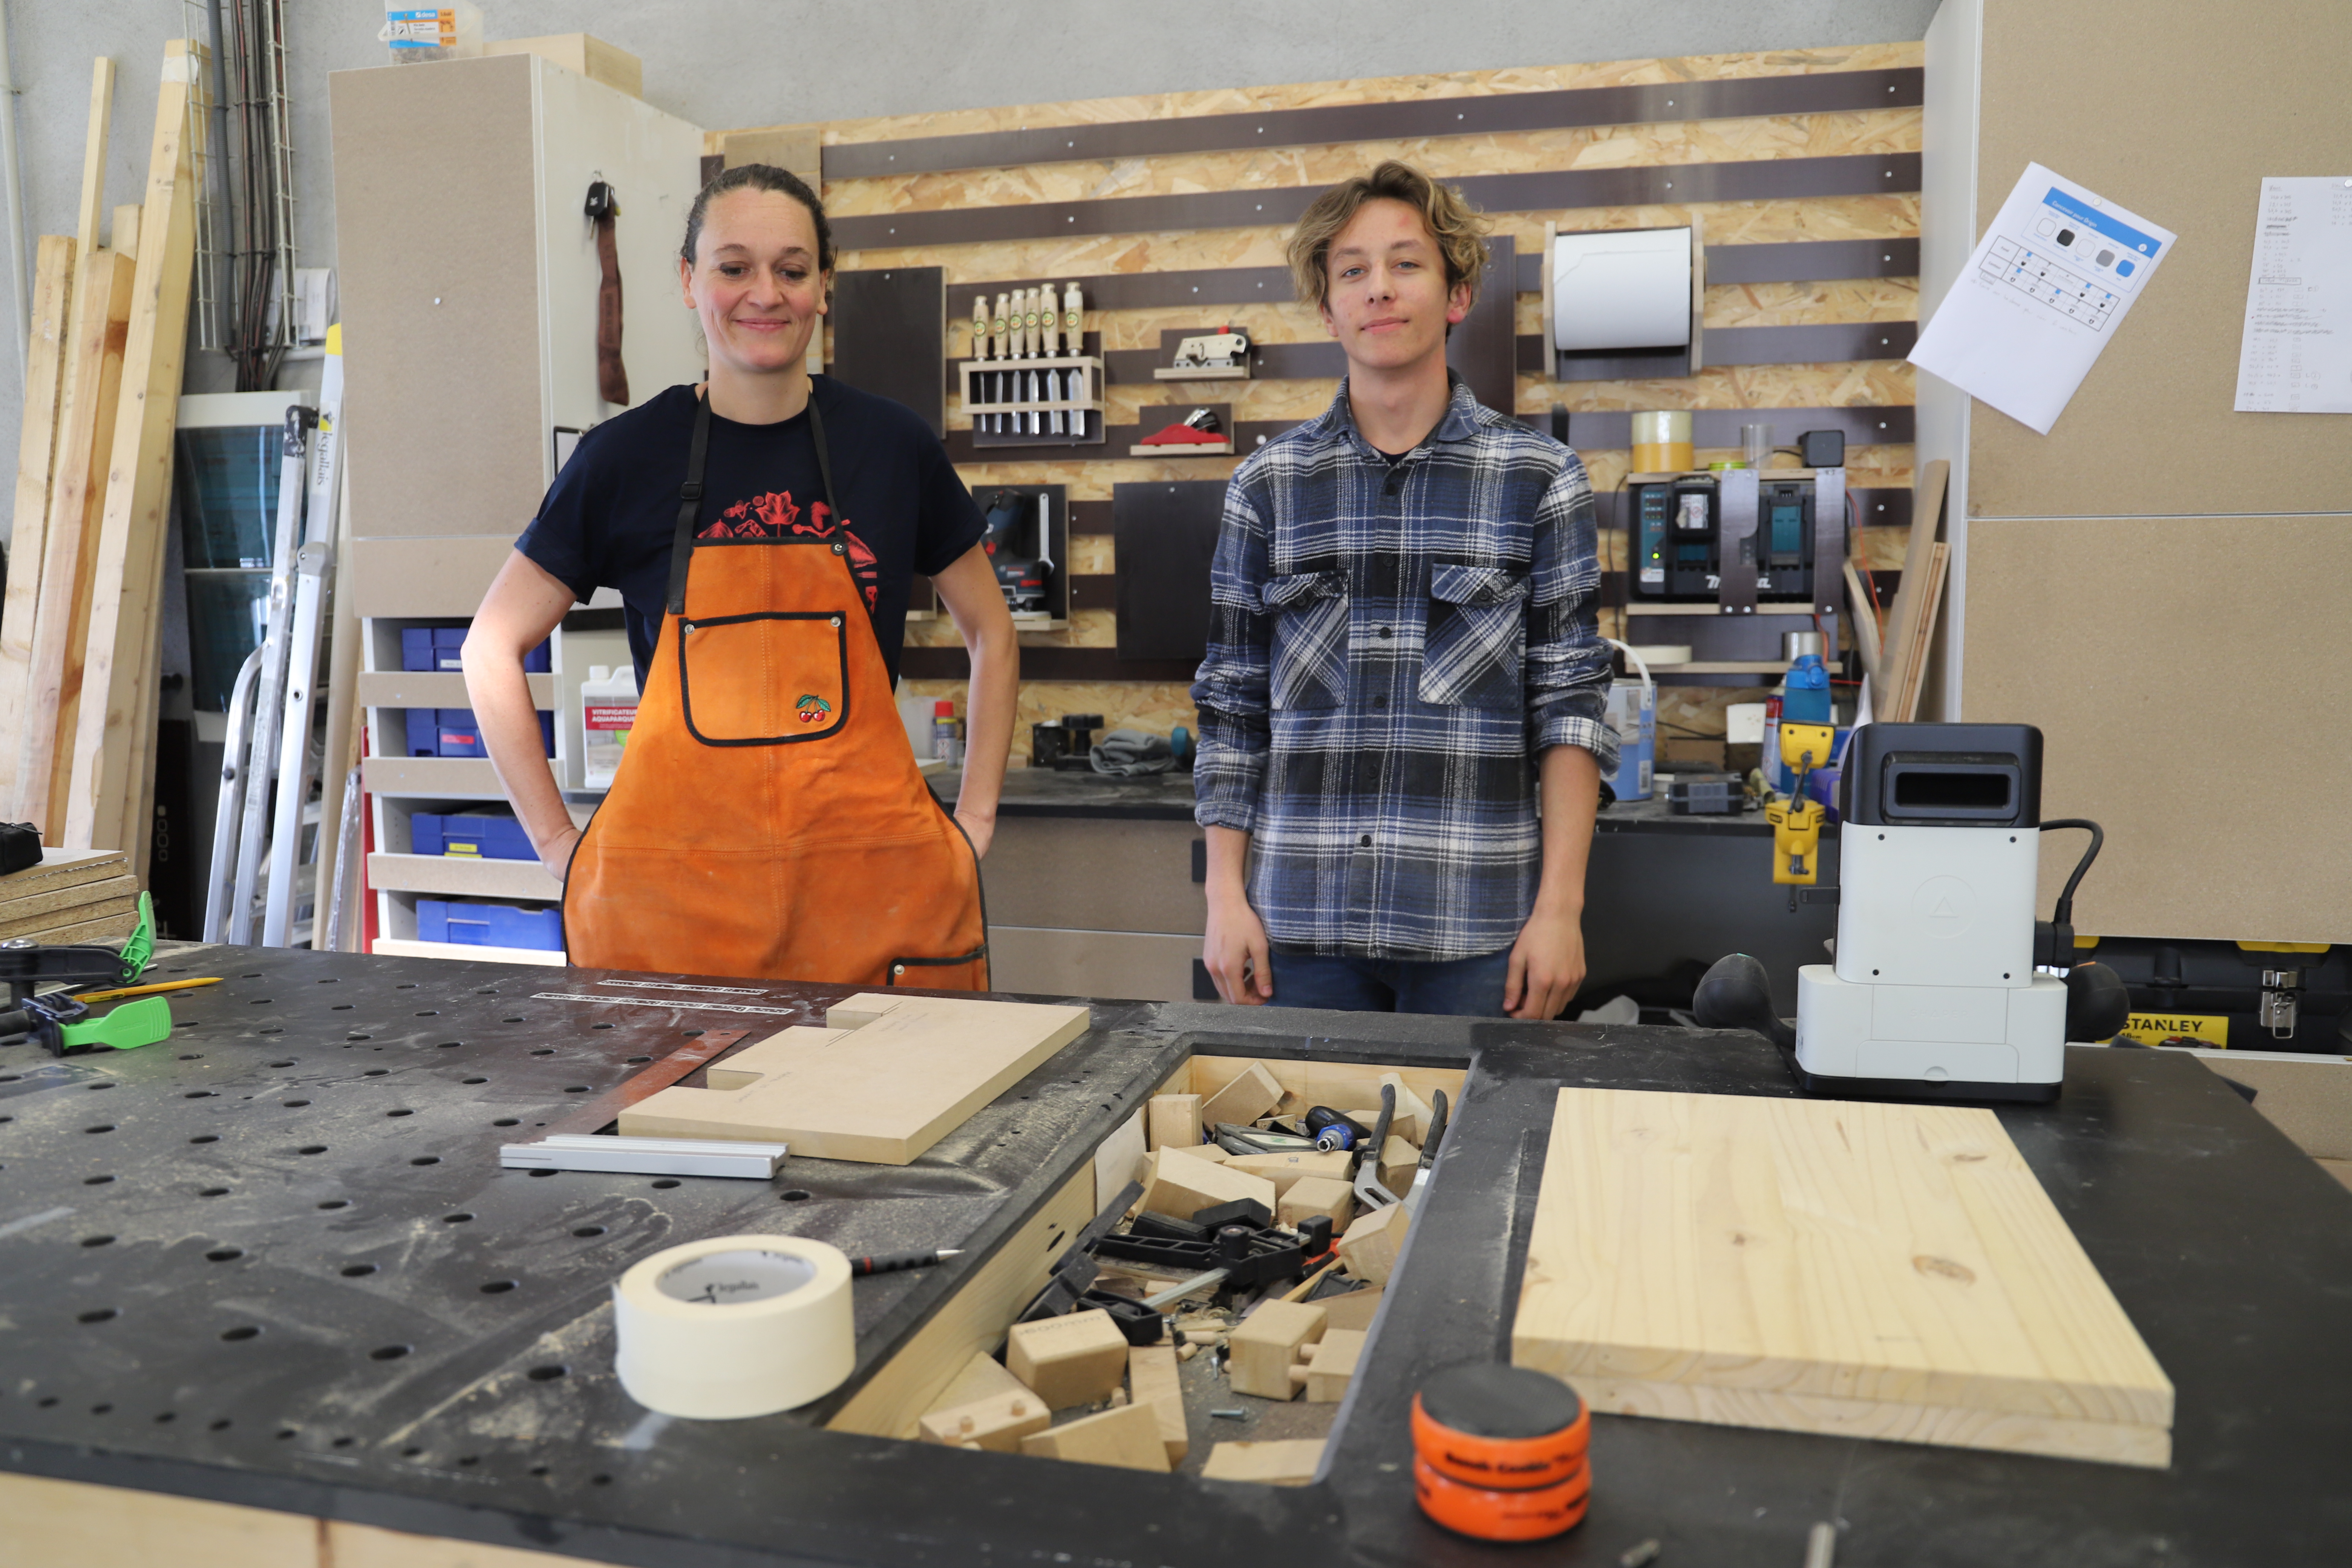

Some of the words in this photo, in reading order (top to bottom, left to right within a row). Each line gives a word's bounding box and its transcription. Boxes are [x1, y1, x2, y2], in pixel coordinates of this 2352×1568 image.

[2052, 201, 2073, 217] Concevoir
[2072, 211, 2085, 222] pour
[2084, 217, 2098, 228] Origin
[317, 432, 332, 485] legallais
